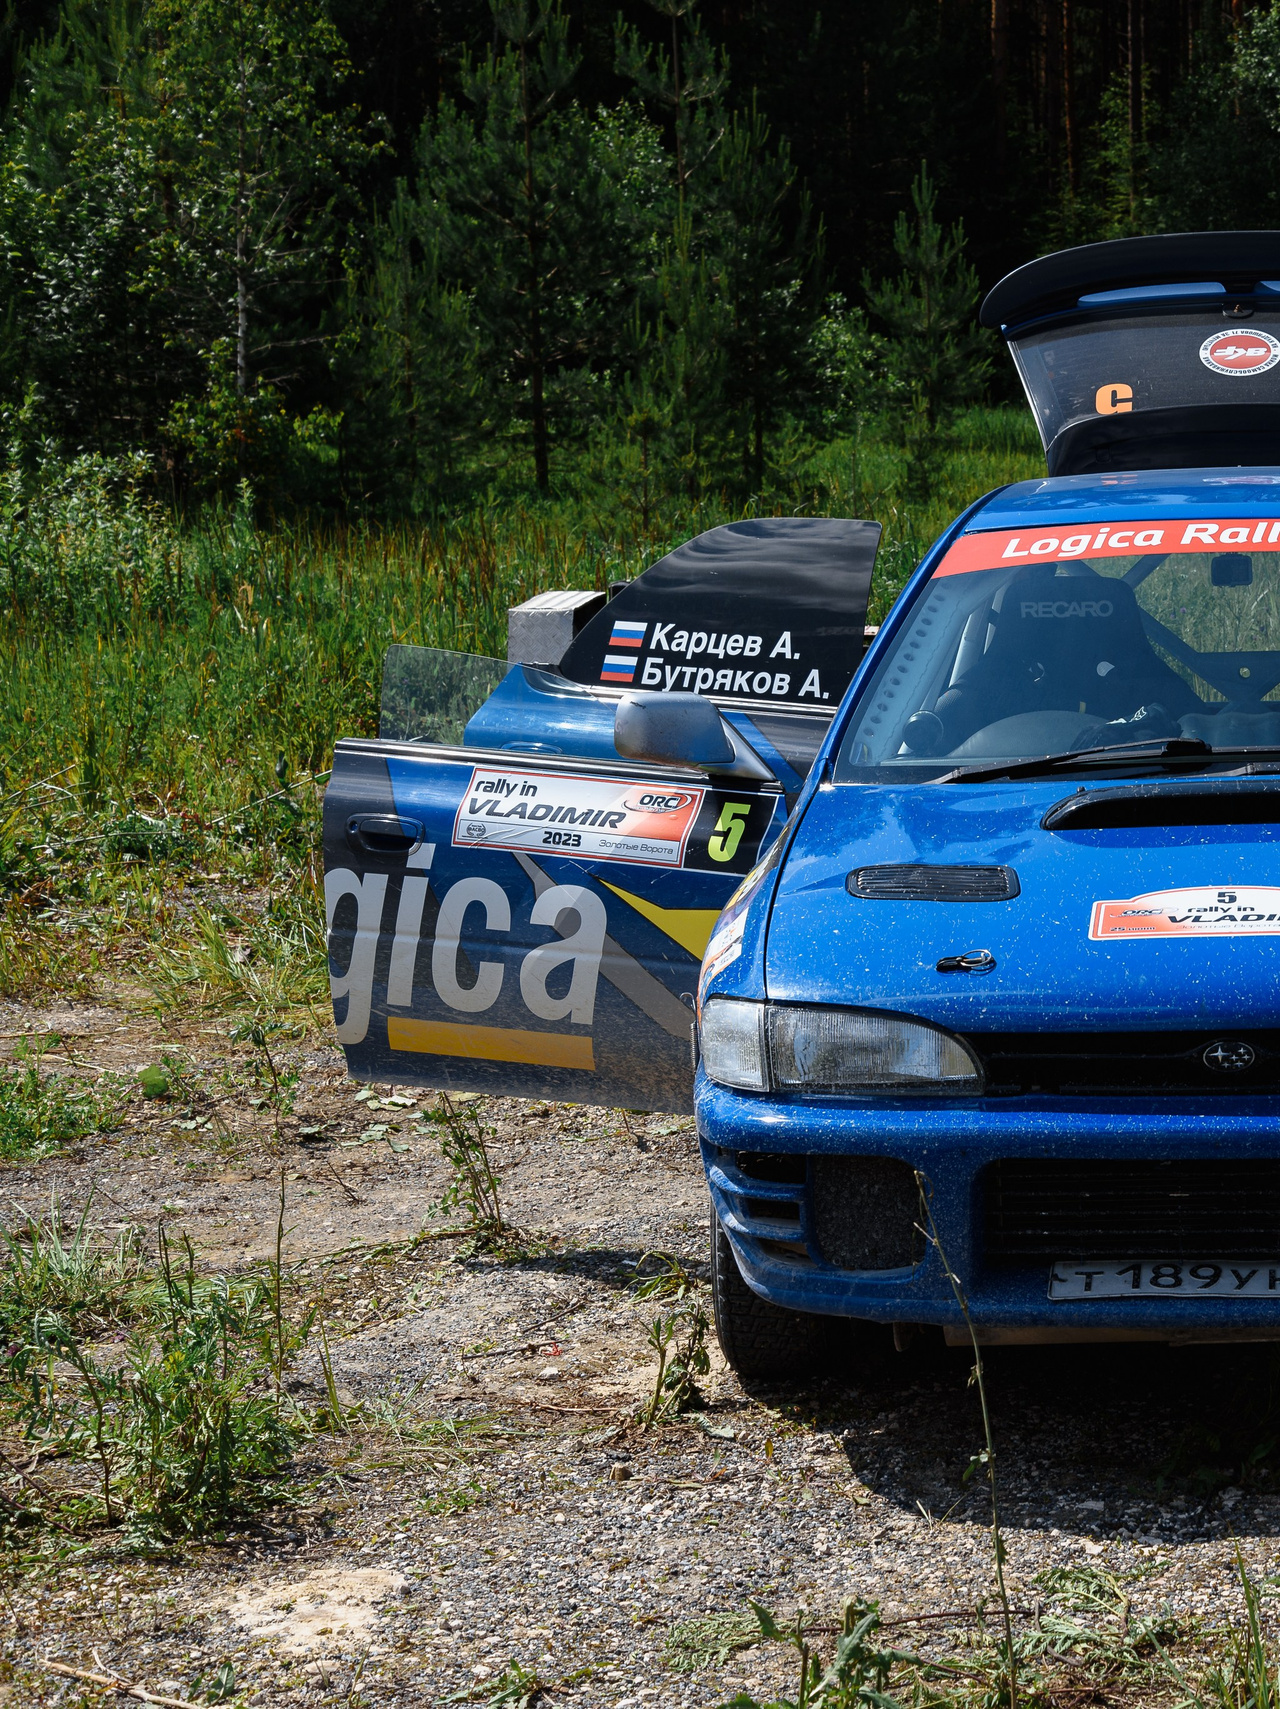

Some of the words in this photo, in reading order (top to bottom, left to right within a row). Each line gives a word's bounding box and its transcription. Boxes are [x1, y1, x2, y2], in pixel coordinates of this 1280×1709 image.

[1001, 526, 1164, 560] Logica
[1020, 601, 1113, 618] RECARO
[649, 622, 763, 659] Карцев
[769, 631, 801, 659] А.
[641, 656, 790, 695] Бутряков
[798, 669, 830, 699] А.
[474, 778, 518, 799] rally
[519, 781, 538, 797] in
[640, 794, 681, 809] ORC
[467, 798, 627, 829] VLADIMIR
[542, 831, 582, 848] 2023
[708, 802, 751, 862] 5
[599, 839, 639, 851] Золотые
[640, 843, 674, 855] Ворота
[1216, 891, 1237, 904] 5
[1187, 905, 1233, 913] rally
[324, 843, 607, 1045] gica
